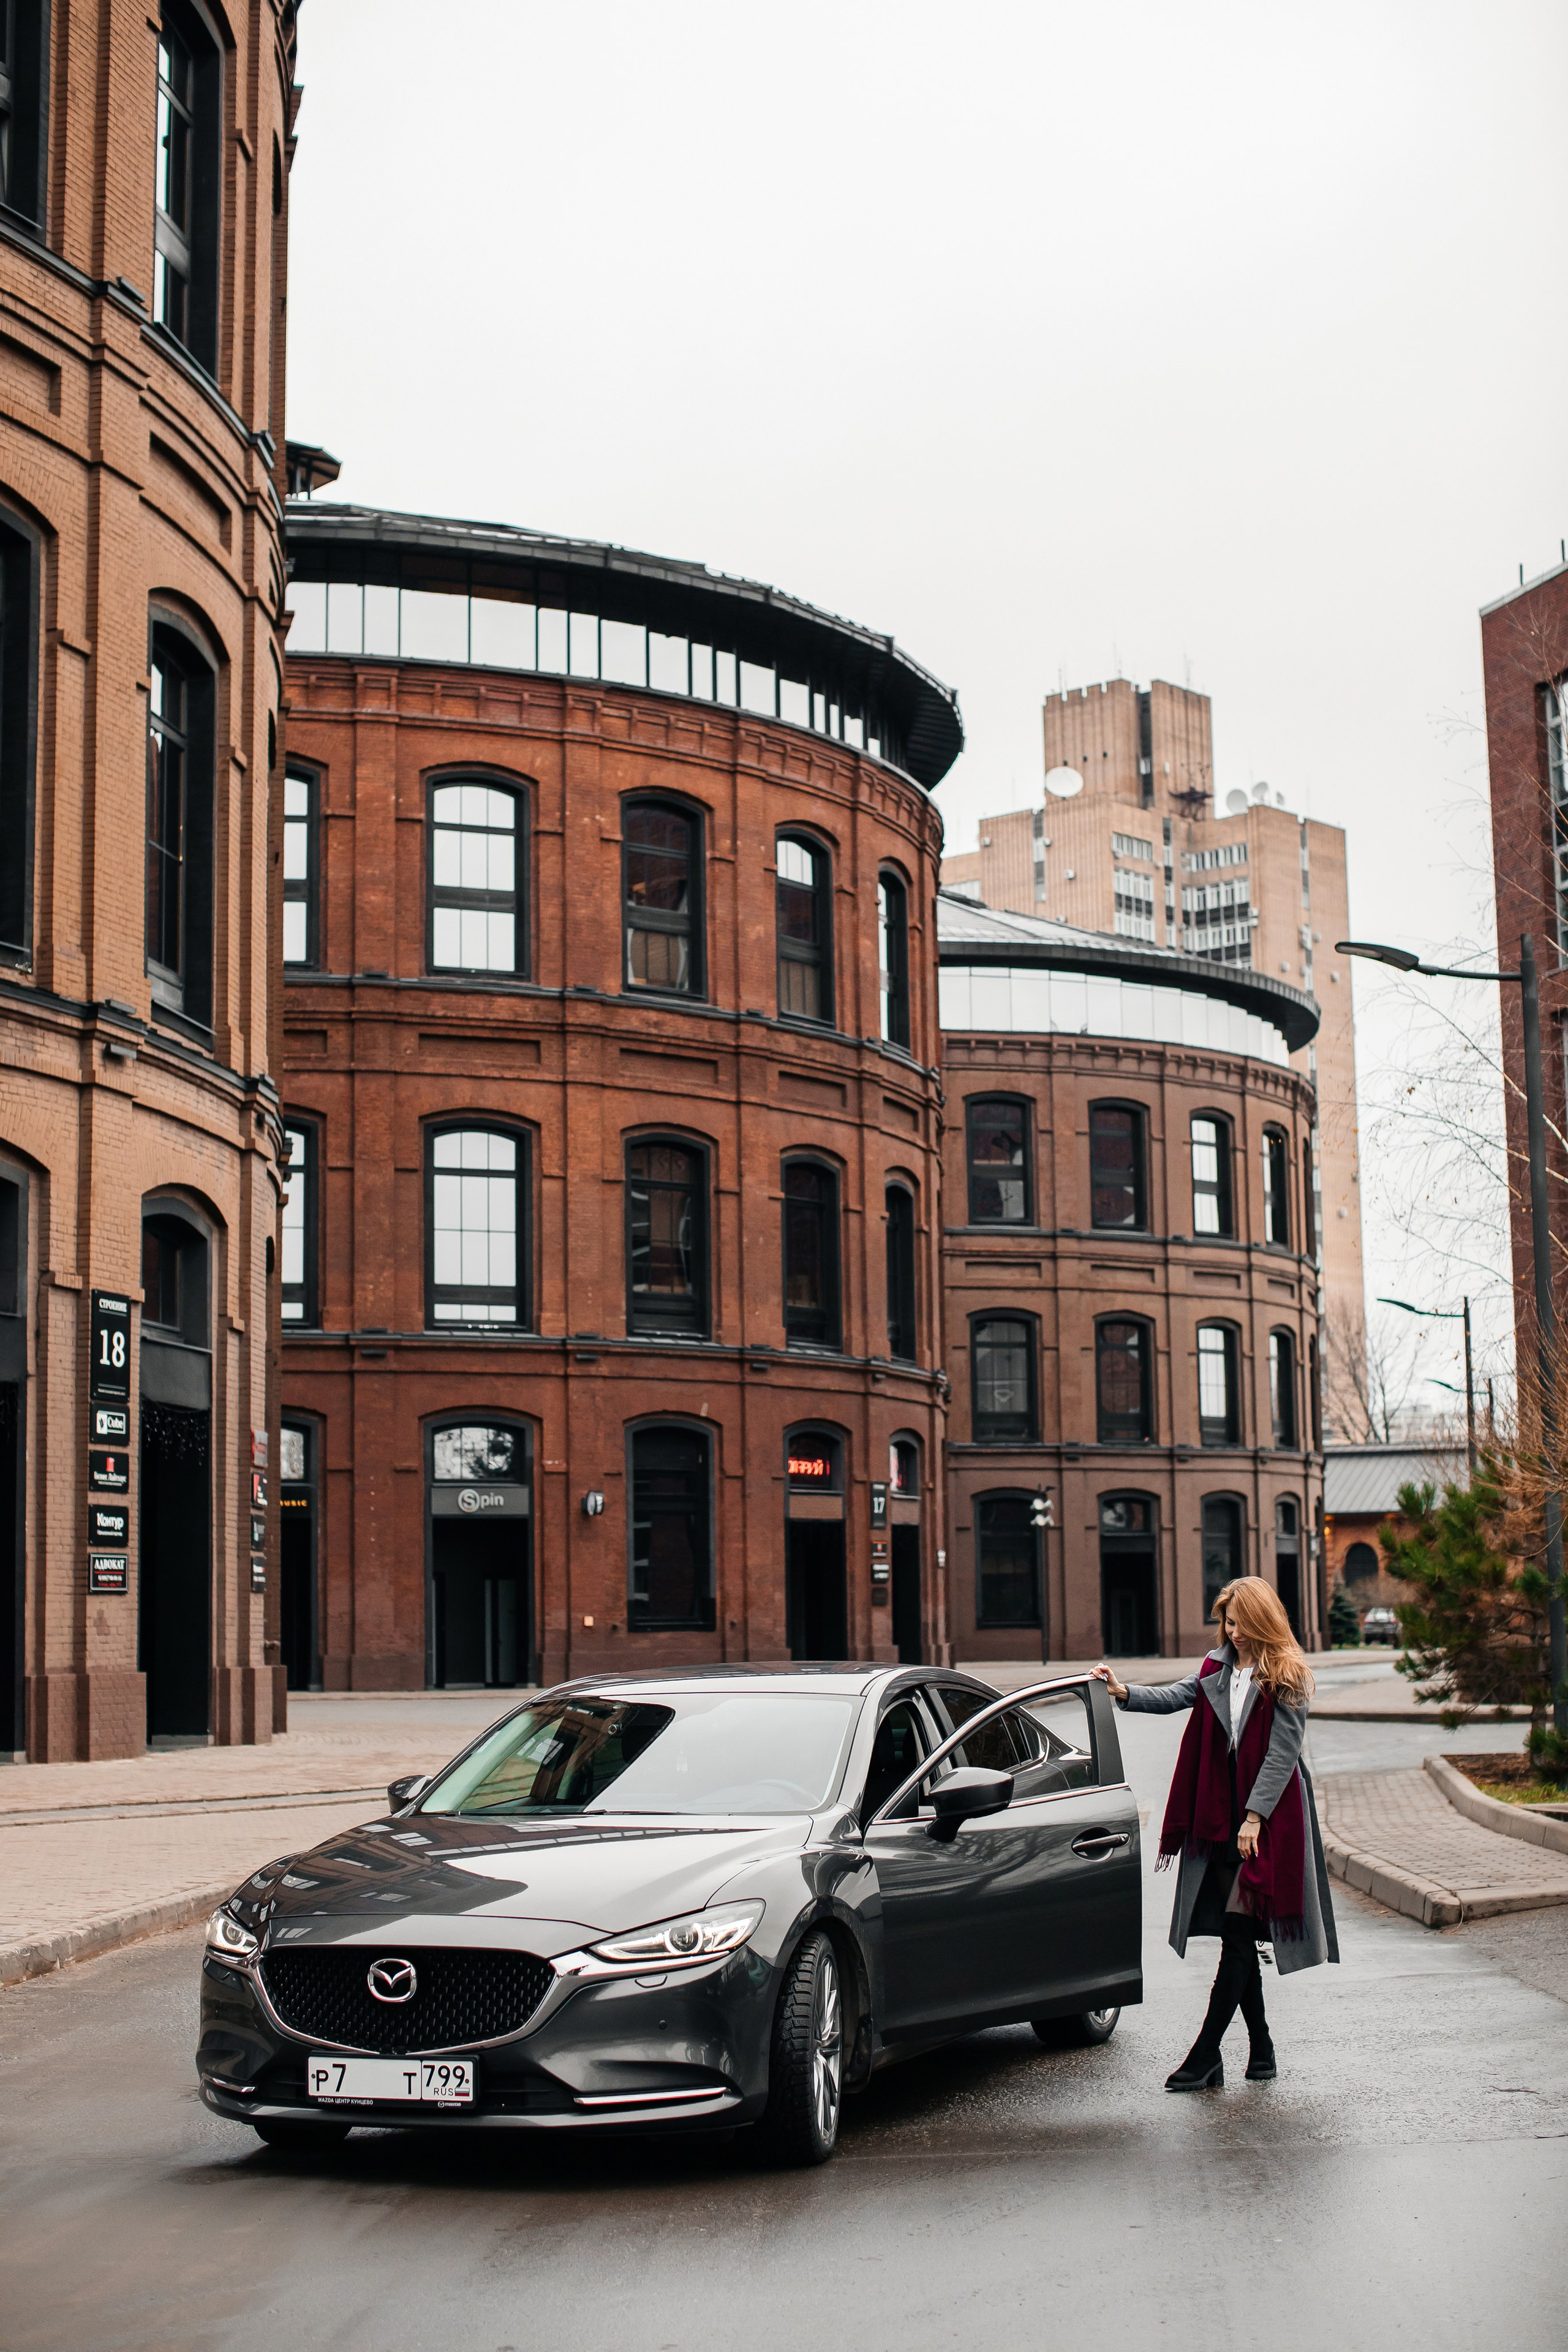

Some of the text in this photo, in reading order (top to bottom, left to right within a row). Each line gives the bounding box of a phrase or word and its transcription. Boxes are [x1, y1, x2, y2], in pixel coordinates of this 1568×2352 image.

[100, 1329, 125, 1368] 18
[458, 1488, 504, 1513] Spin
[873, 1497, 885, 1513] 17
[97, 1512, 124, 1530] Контур
[94, 1559, 125, 1571] АДВОКАТ
[423, 2064, 466, 2087] 799
[434, 2087, 454, 2096] RUS
